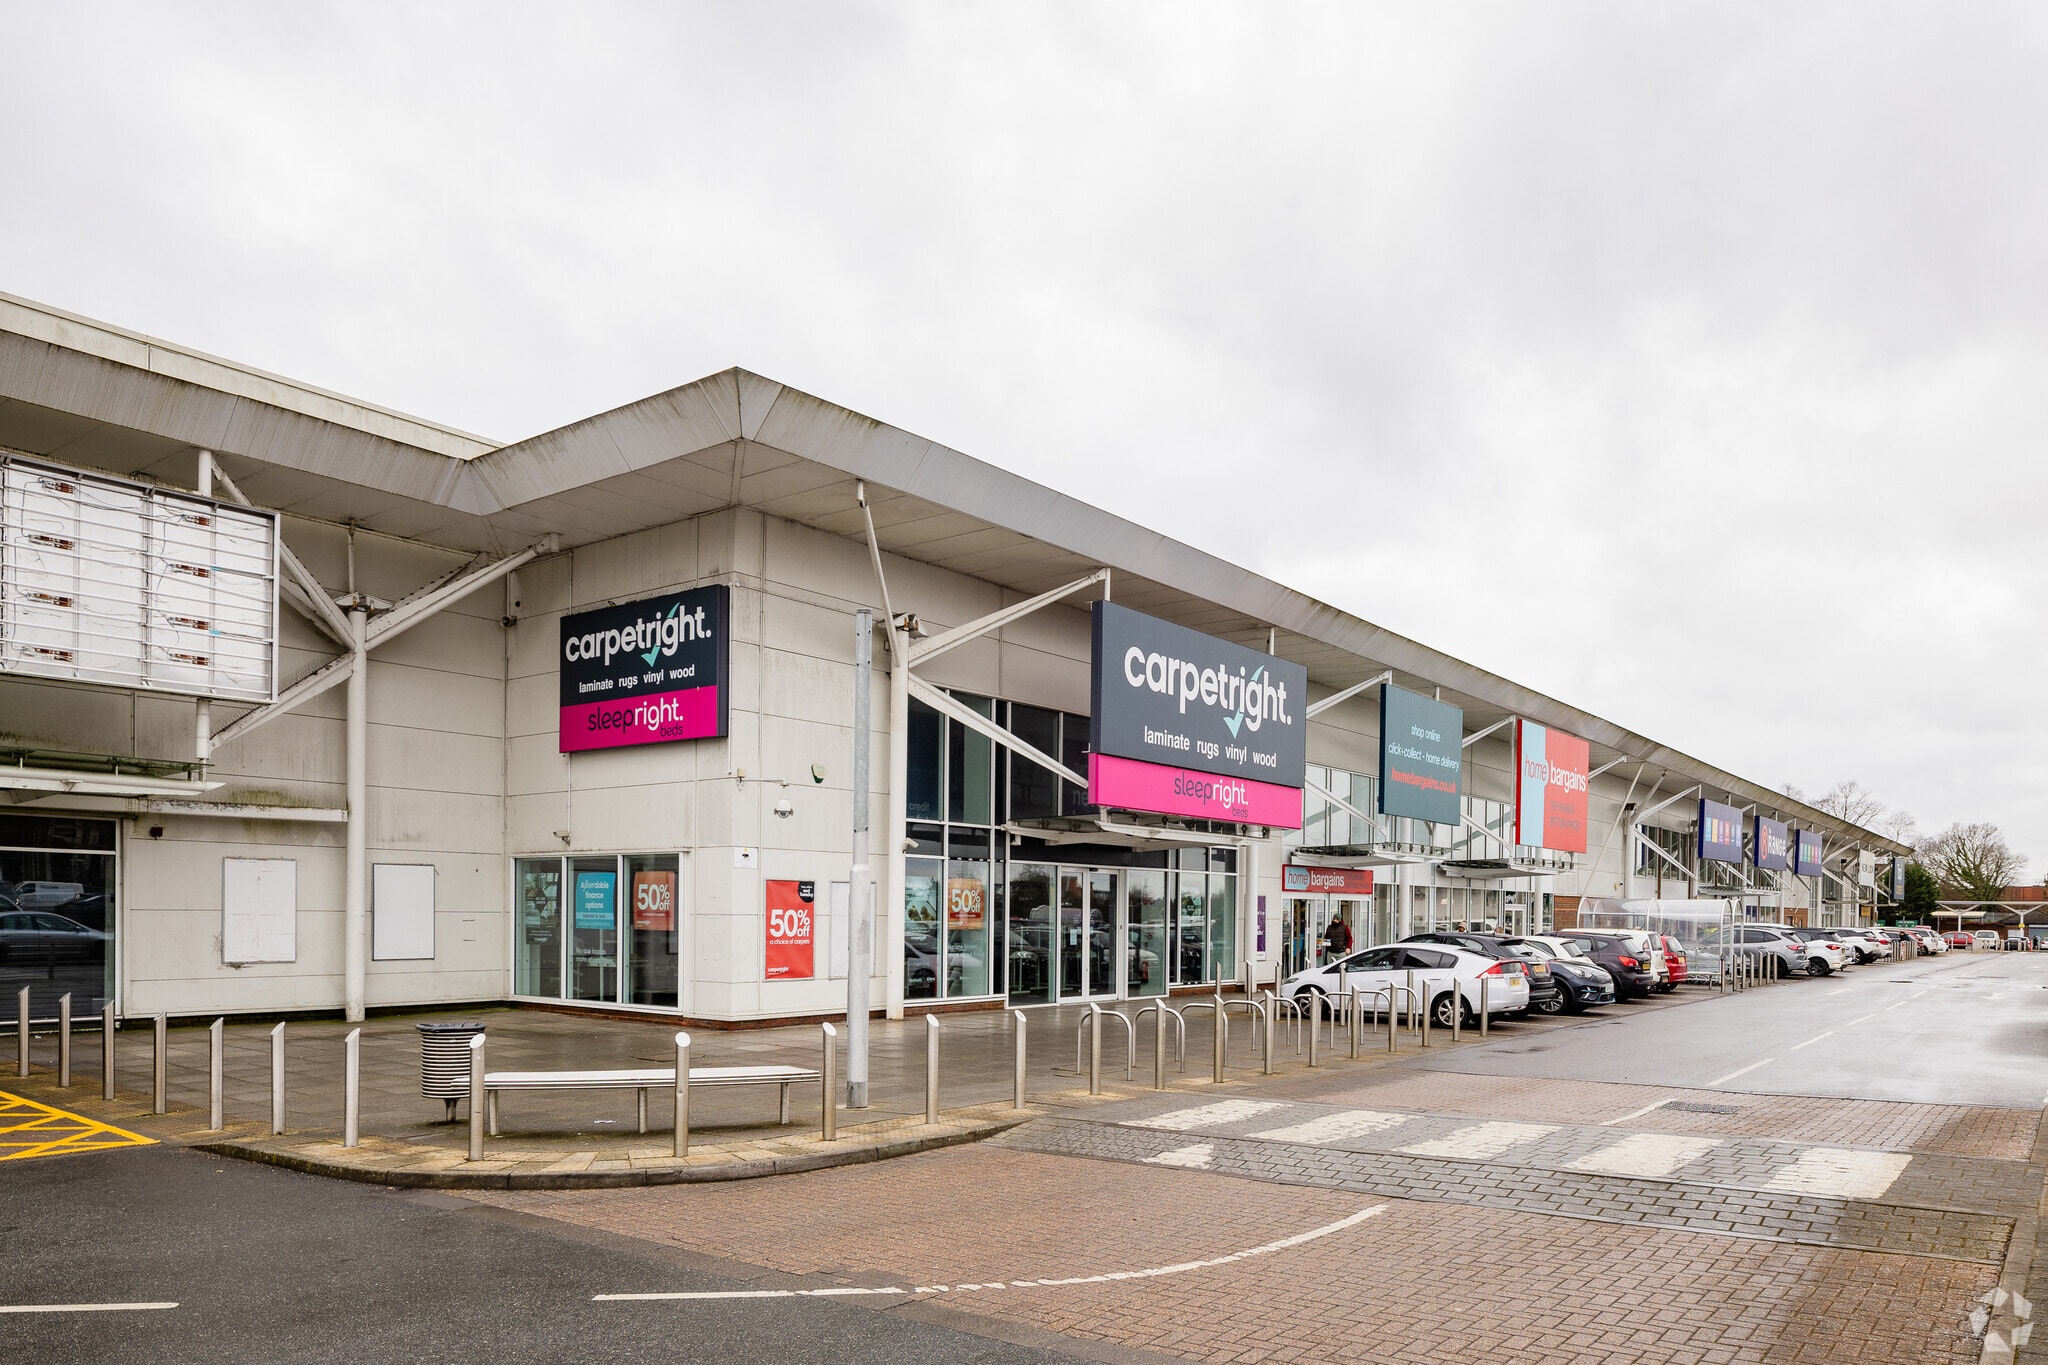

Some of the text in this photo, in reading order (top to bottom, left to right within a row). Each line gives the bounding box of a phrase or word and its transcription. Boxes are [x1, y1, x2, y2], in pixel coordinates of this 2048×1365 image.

[579, 664, 695, 693] laminate rugs vinyl wood
[660, 724, 683, 737] beds
[1411, 724, 1441, 742] shop online
[1144, 725, 1277, 768] laminate rugs vinyl wood
[1425, 751, 1440, 765] home
[1441, 755, 1460, 773] delivery
[1391, 766, 1457, 794] homebargains.co.uk
[1524, 754, 1586, 793] home bargains
[1232, 806, 1249, 818] beds
[580, 880, 609, 891] Affordable
[1288, 870, 1345, 889] home bargains
[585, 891, 604, 899] finance
[637, 883, 670, 910] 50%
[951, 889, 980, 913] 50%
[585, 902, 604, 910] options
[659, 902, 671, 911] off
[971, 903, 981, 913] off
[769, 909, 810, 938] 50%
[796, 925, 810, 937] off
